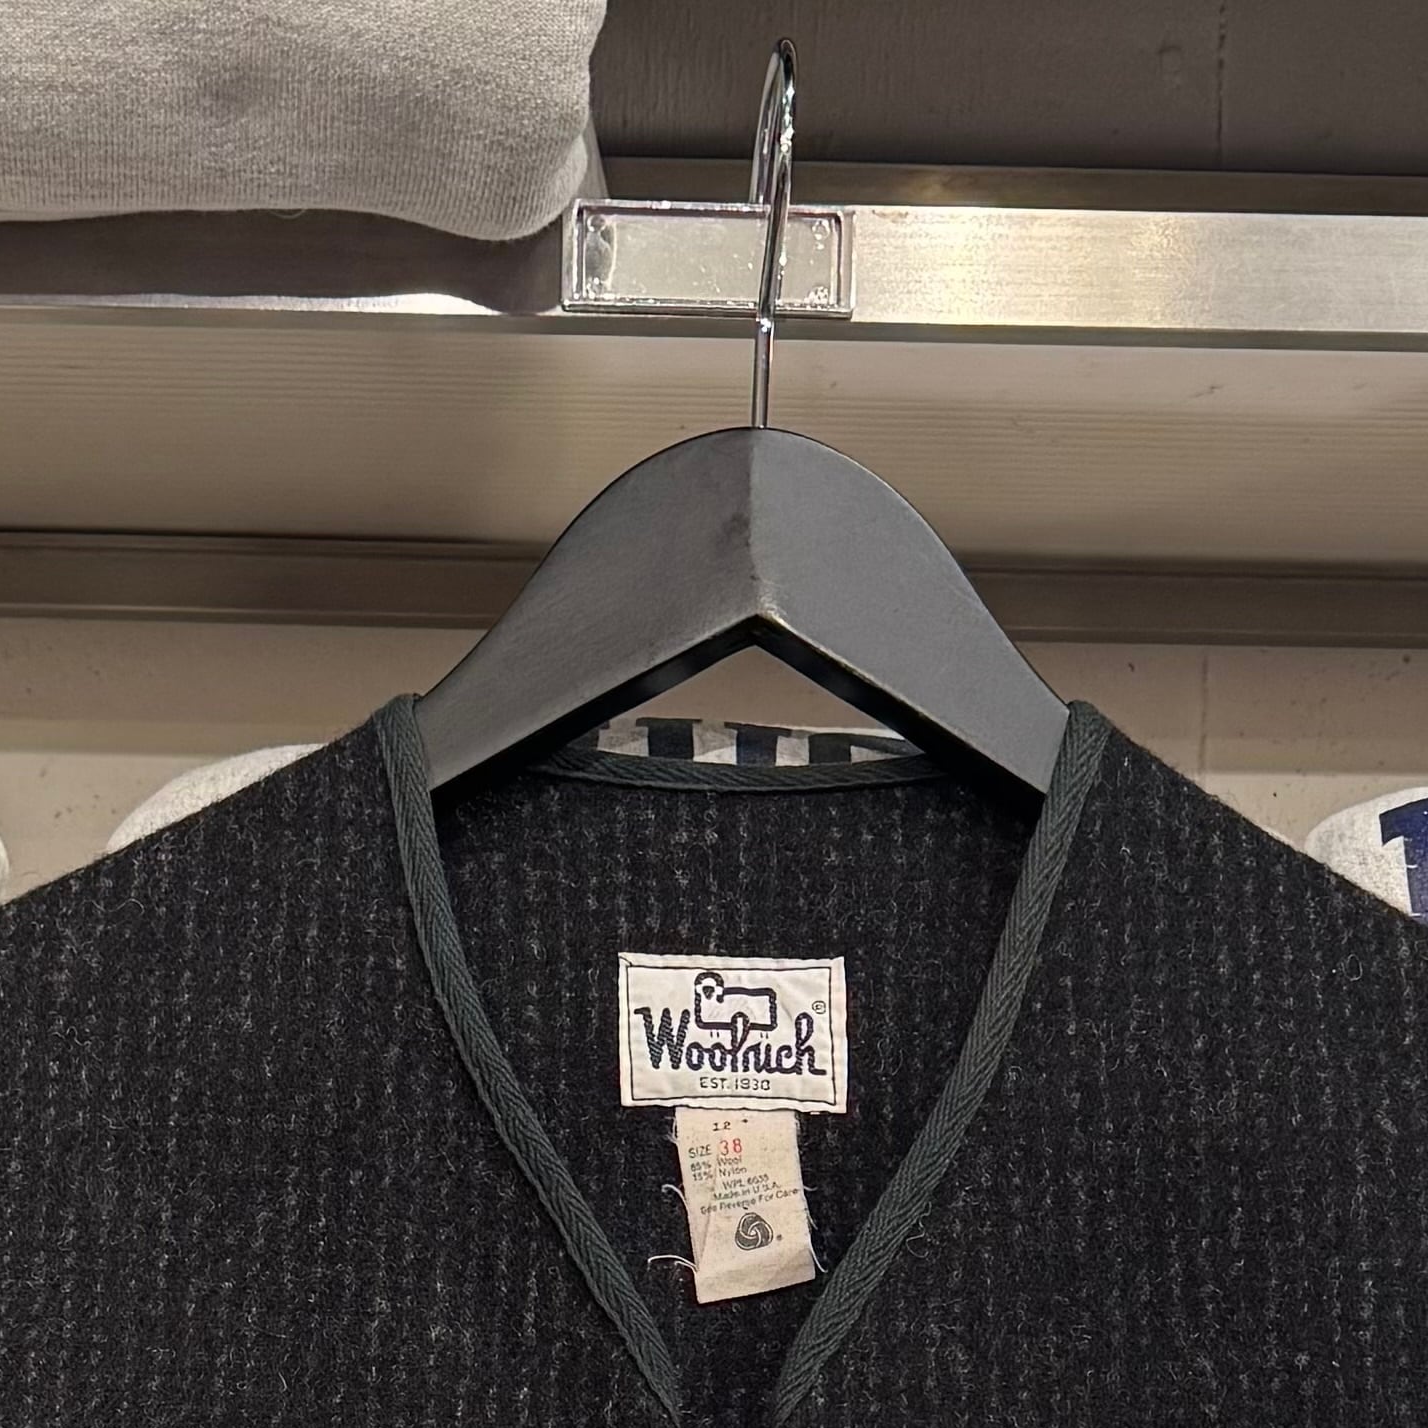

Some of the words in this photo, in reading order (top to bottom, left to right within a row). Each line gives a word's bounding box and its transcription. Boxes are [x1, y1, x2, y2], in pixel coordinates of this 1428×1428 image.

[633, 1006, 827, 1076] Woolrich
[688, 1144, 712, 1158] SIZE
[719, 1138, 742, 1156] 38
[717, 1155, 742, 1167] Wool
[719, 1167, 747, 1178] Nylon
